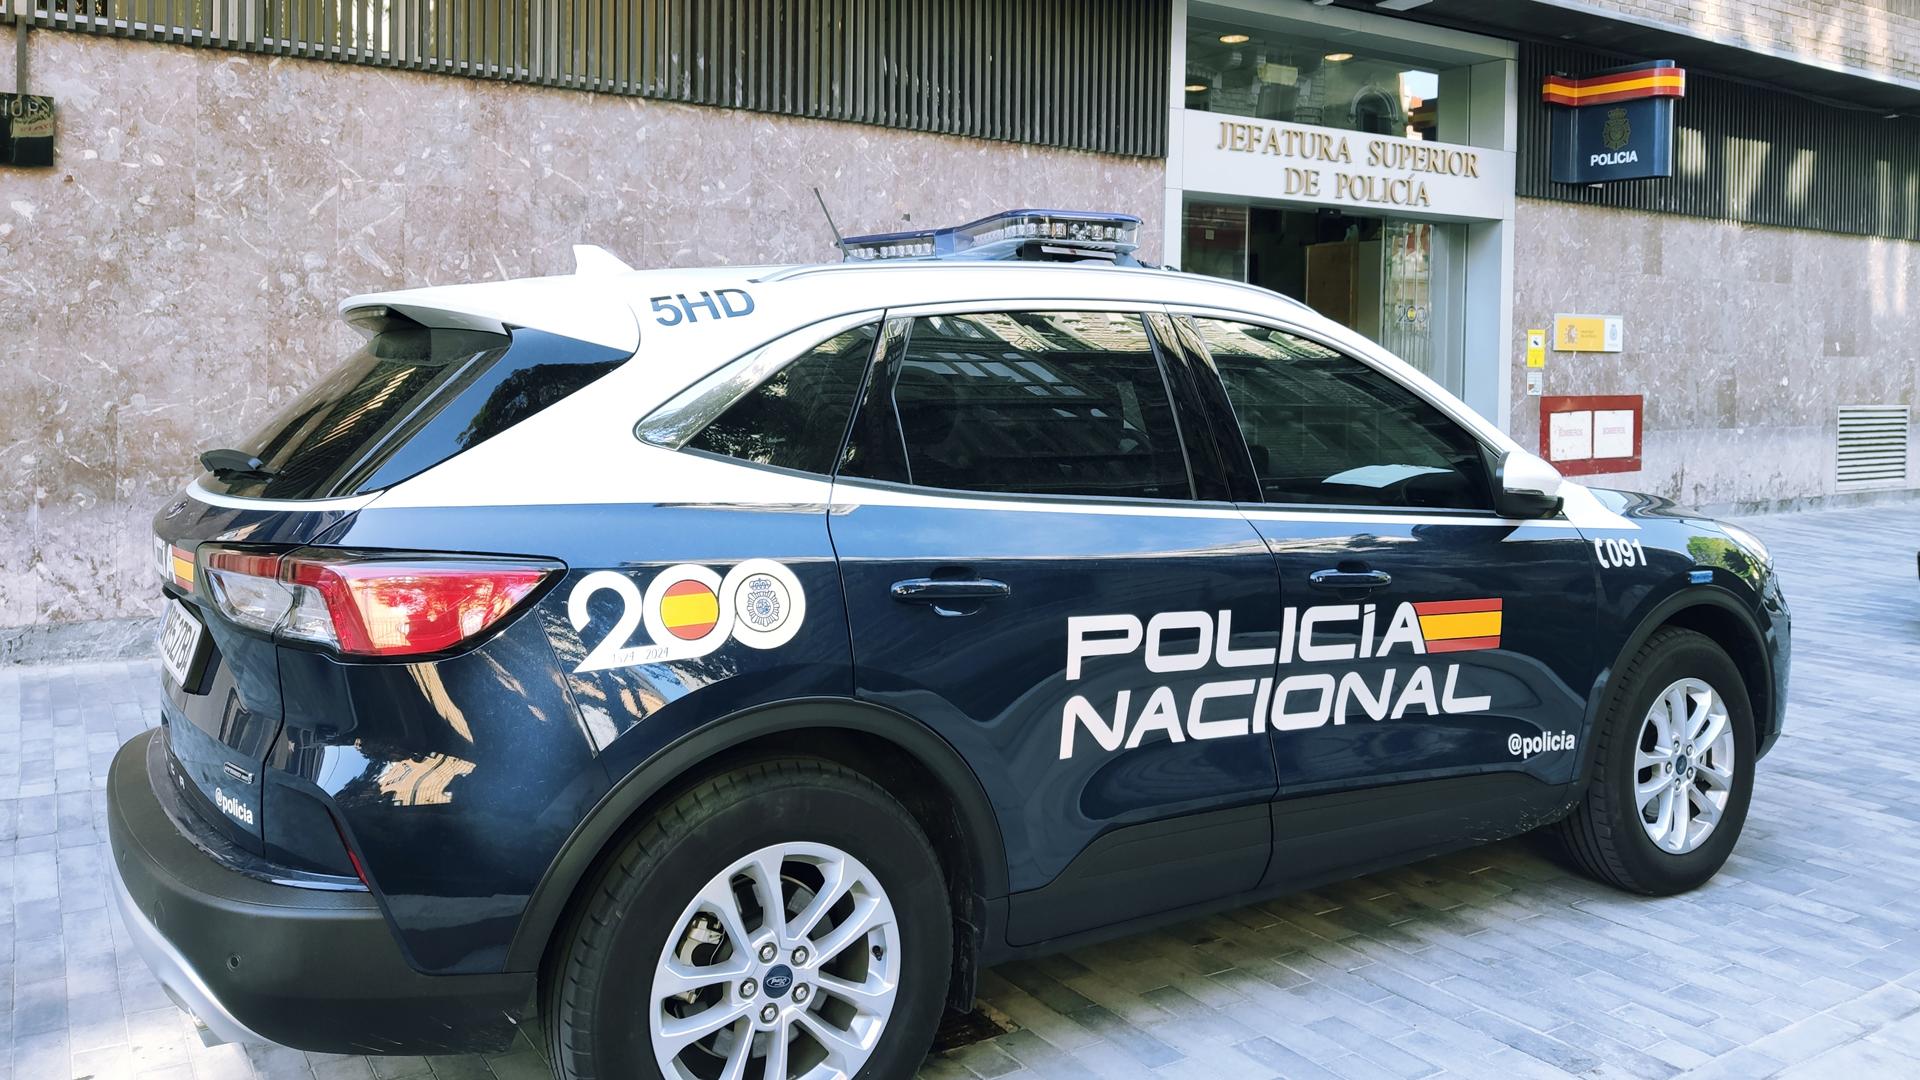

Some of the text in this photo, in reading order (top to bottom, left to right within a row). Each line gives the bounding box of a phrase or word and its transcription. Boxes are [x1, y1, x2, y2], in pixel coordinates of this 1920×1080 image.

[1218, 122, 1479, 178] JEFATURA SUPERIOR
[1590, 150, 1638, 166] POLICIA
[1284, 167, 1431, 207] DE POLICÍA
[650, 288, 755, 326] 5HD
[1606, 538, 1647, 568] 091
[568, 558, 806, 673] 200
[1059, 664, 1491, 759] NACIONAL
[1508, 730, 1576, 759] @policia
[215, 787, 253, 825] @policia
